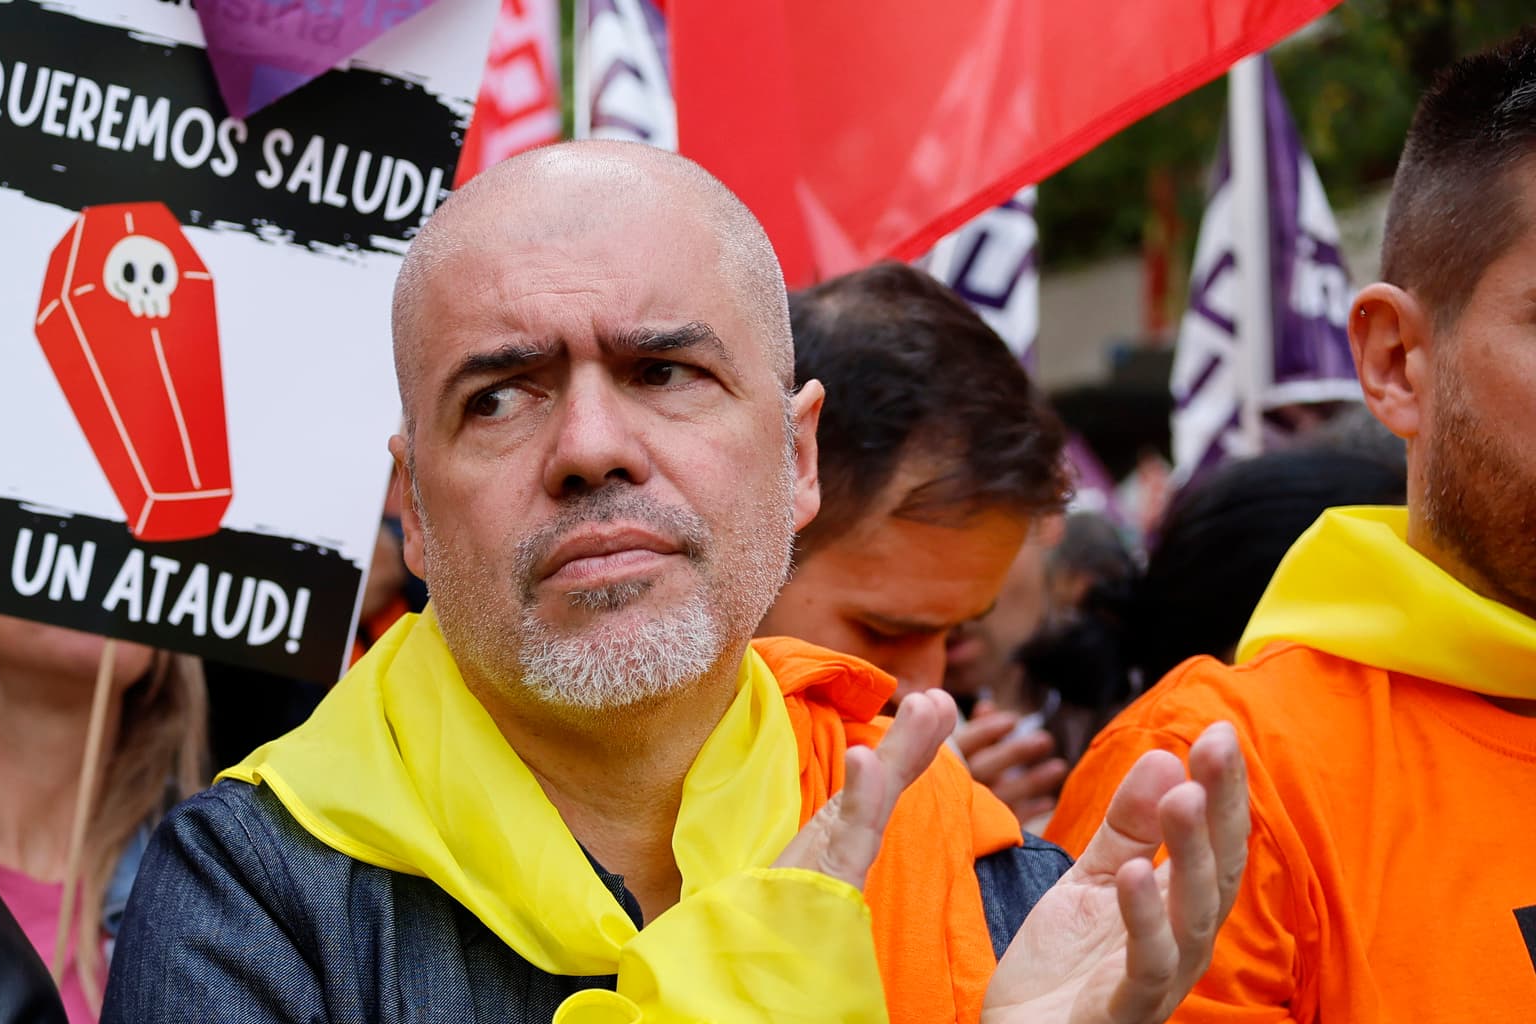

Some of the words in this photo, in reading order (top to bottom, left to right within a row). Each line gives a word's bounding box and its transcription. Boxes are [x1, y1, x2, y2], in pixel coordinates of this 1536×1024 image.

[255, 127, 444, 222] SALUD!
[11, 527, 97, 601] UN
[102, 547, 311, 654] ATAUD!
